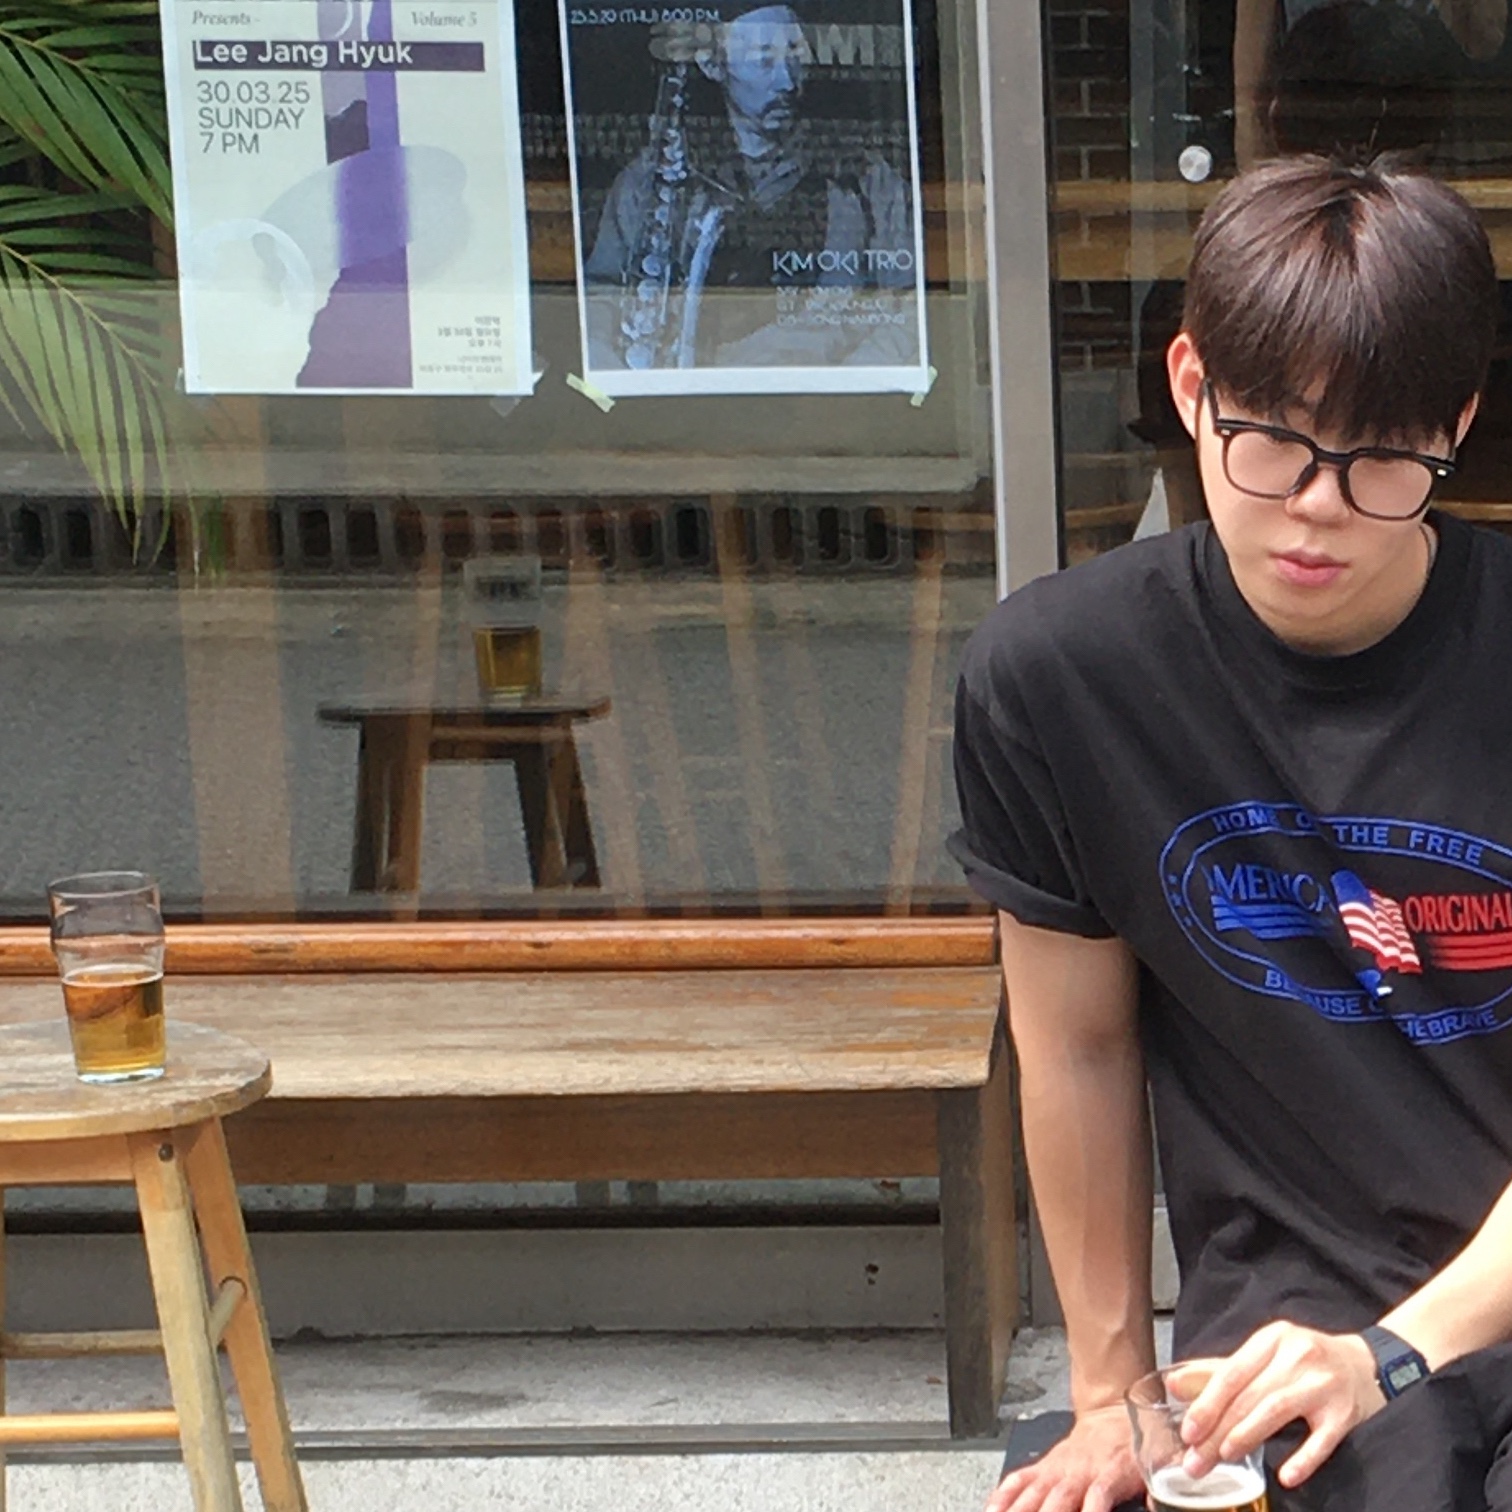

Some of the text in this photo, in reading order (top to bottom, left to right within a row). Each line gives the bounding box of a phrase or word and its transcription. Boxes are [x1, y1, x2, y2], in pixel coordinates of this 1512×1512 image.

[192, 9, 251, 26] Presents
[411, 11, 465, 27] Volume
[195, 40, 413, 69] Lee Jang Hyuk
[196, 80, 311, 104] 30.03.25
[198, 106, 305, 129] SUNDAY
[200, 132, 260, 154] 7 PM
[1332, 824, 1389, 846] THE
[1409, 830, 1484, 866] FREE
